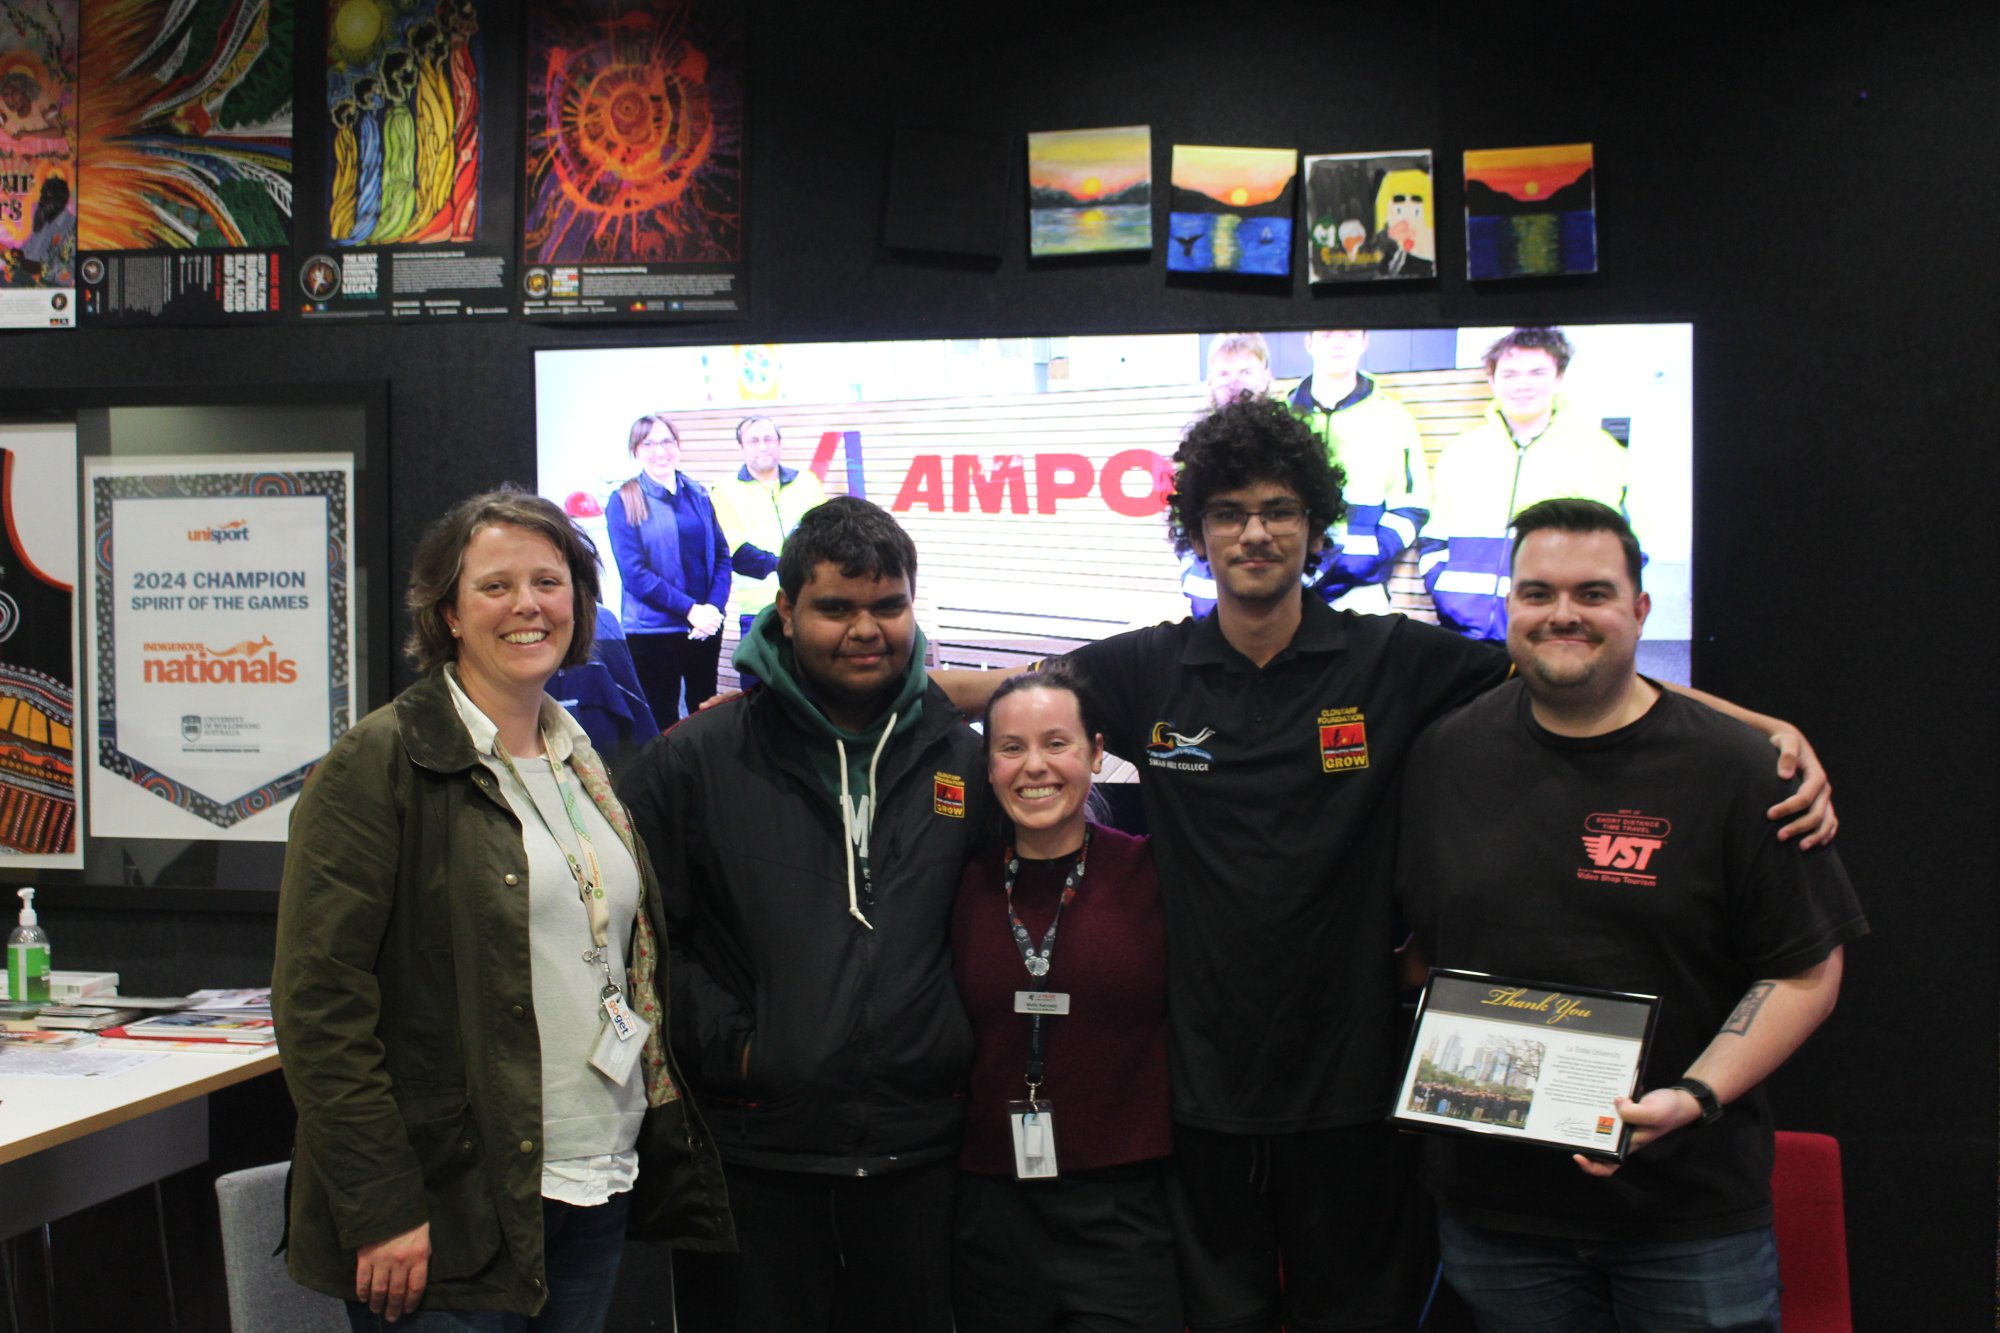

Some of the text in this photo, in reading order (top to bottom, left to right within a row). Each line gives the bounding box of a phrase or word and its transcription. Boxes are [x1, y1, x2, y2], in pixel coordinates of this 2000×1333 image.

[0, 174, 34, 193] ur
[342, 284, 376, 294] LEGACY
[890, 448, 1175, 517] AMPO
[187, 526, 249, 545] unisport
[133, 571, 305, 590] 2024 CHAMPION
[131, 595, 309, 611] SPIRIT OF THE GAMES
[143, 642, 205, 652] INDIGENOUS
[143, 651, 298, 684] nationals
[1148, 757, 1166, 768] SWAN
[1177, 762, 1209, 772] COLLEGE
[1326, 755, 1366, 769] GROW
[937, 803, 963, 816] GROW
[1596, 817, 1660, 829] SHORT DISTANCE
[1622, 826, 1650, 834] TRAVEL
[1582, 834, 1663, 871] VST
[1577, 872, 1657, 887] Video Shop Tourism
[1480, 987, 1593, 1025] Thank You
[607, 999, 629, 1035] goget
